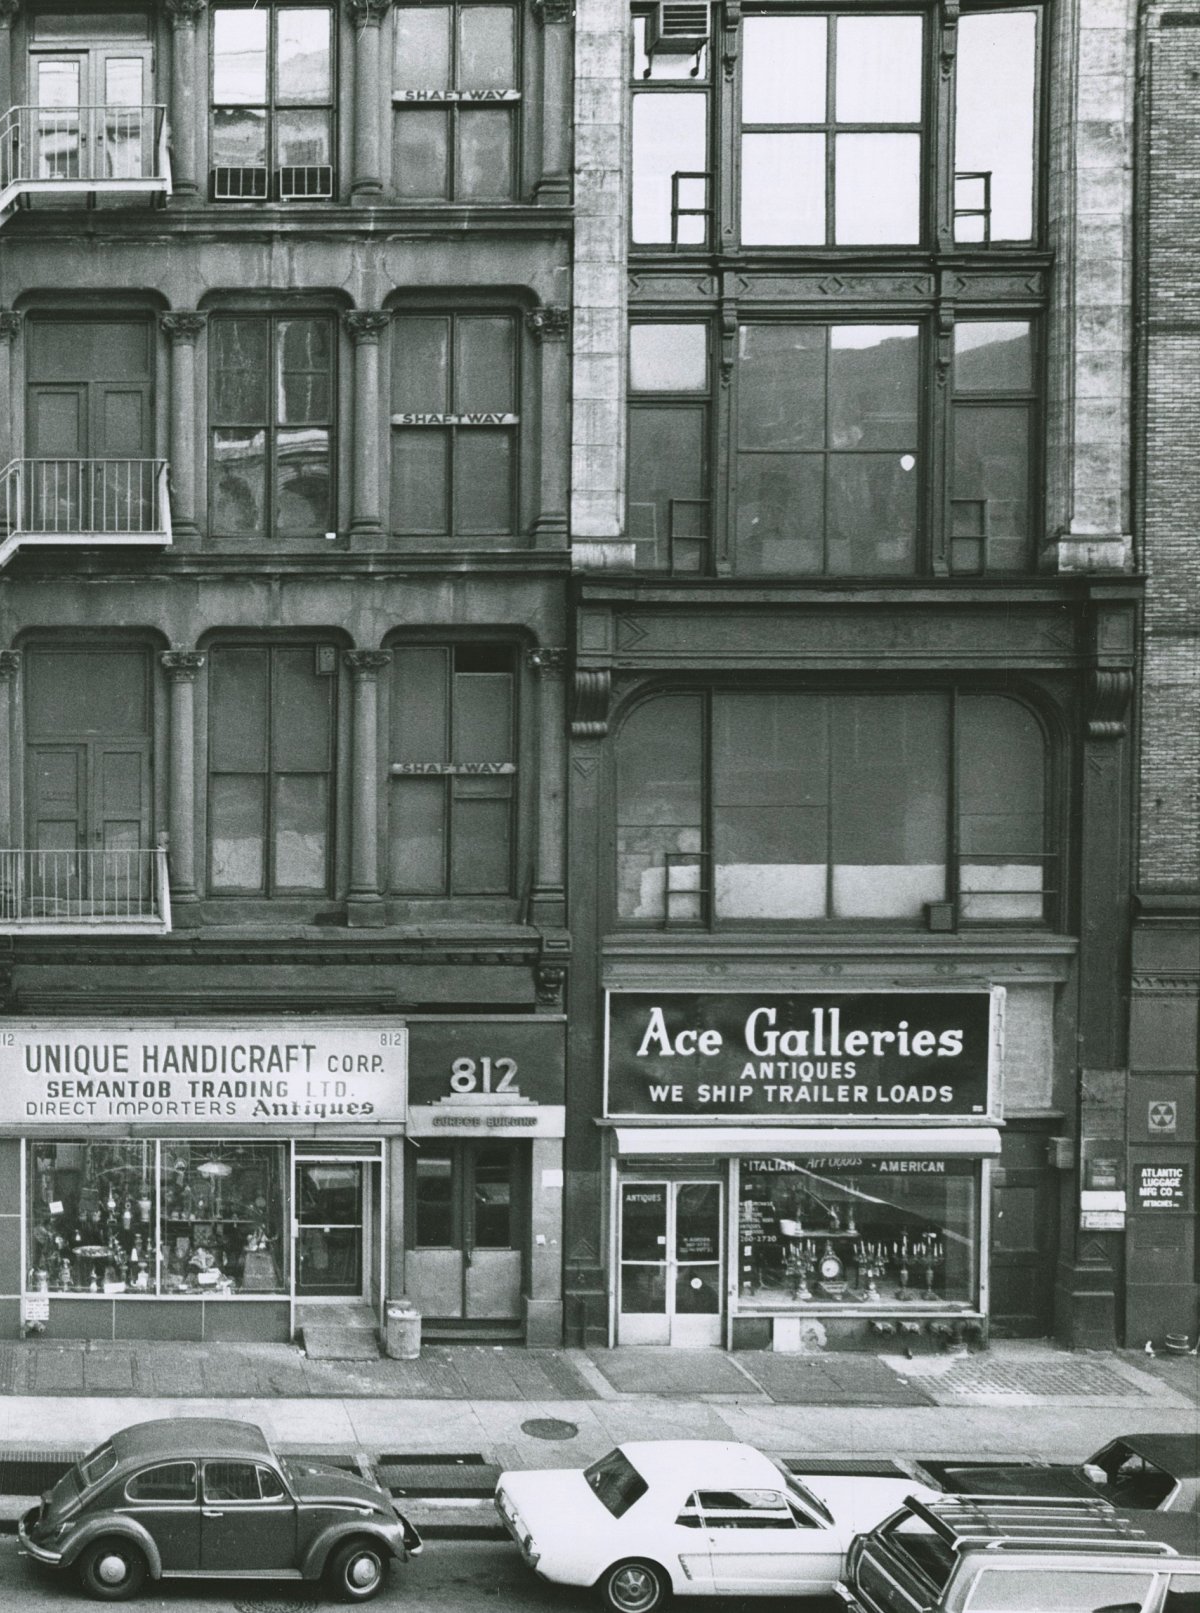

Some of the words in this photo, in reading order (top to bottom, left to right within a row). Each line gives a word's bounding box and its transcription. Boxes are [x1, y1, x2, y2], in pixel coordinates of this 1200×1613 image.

[405, 90, 508, 100] SHAFTWAY
[402, 413, 507, 424] SHAFTWAY
[401, 763, 505, 774] SHAFTWAY
[636, 1007, 723, 1057] Ace
[745, 1007, 964, 1057] Galleries
[380, 1033, 401, 1046] 812
[25, 1045, 129, 1075] UNIQUE
[142, 1044, 316, 1073] HANDICRAFT
[327, 1054, 385, 1073] CORP.
[450, 1057, 520, 1093] 812
[740, 1062, 856, 1082] ANTIQUES
[47, 1081, 171, 1098] SEMANTOB
[188, 1080, 288, 1098] TRADING
[306, 1080, 355, 1098] LTD.
[650, 1085, 683, 1102] WE
[698, 1085, 753, 1102] SHIP
[764, 1085, 868, 1102] TRAILER
[877, 1085, 954, 1102] LOADS
[26, 1101, 97, 1115] DIRECT
[109, 1101, 236, 1115] IMPORTERS
[251, 1099, 374, 1118] Antiques
[485, 1116, 538, 1127] BUILDING
[749, 1160, 796, 1172] ITALIAN
[879, 1161, 945, 1172] AMERICAN
[1141, 1168, 1183, 1178] ATLANTIC
[1142, 1178, 1180, 1187] LUGGAGE
[1160, 1187, 1173, 1196] CO
[626, 1194, 661, 1203] ANTIQUES
